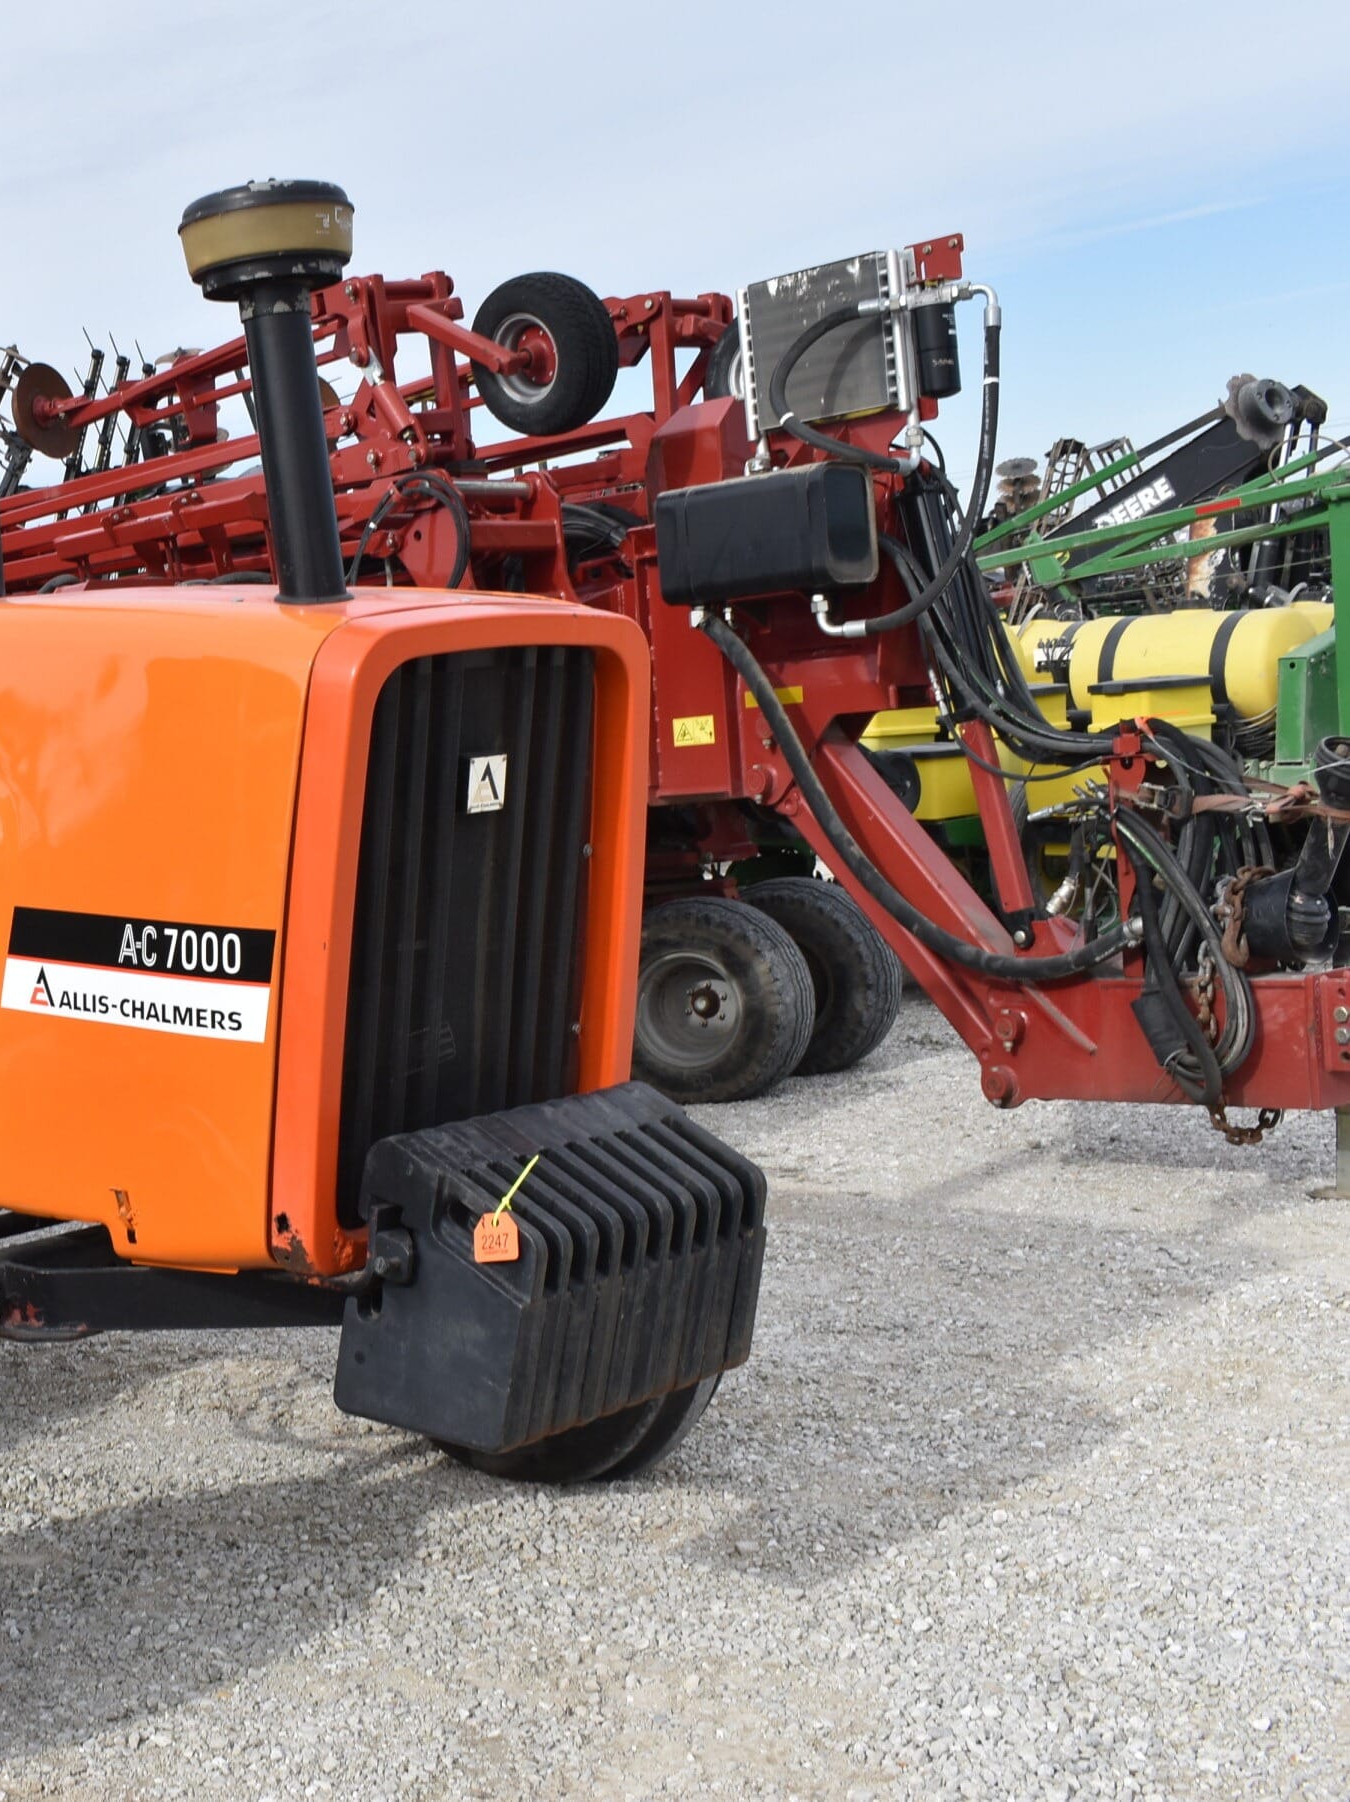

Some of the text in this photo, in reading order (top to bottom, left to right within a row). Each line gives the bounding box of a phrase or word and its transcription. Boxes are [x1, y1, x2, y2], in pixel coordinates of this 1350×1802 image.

[118, 923, 241, 975] A-C 7000
[59, 990, 243, 1031] ALLIS-CHALMERS
[481, 1232, 509, 1250] 2247
